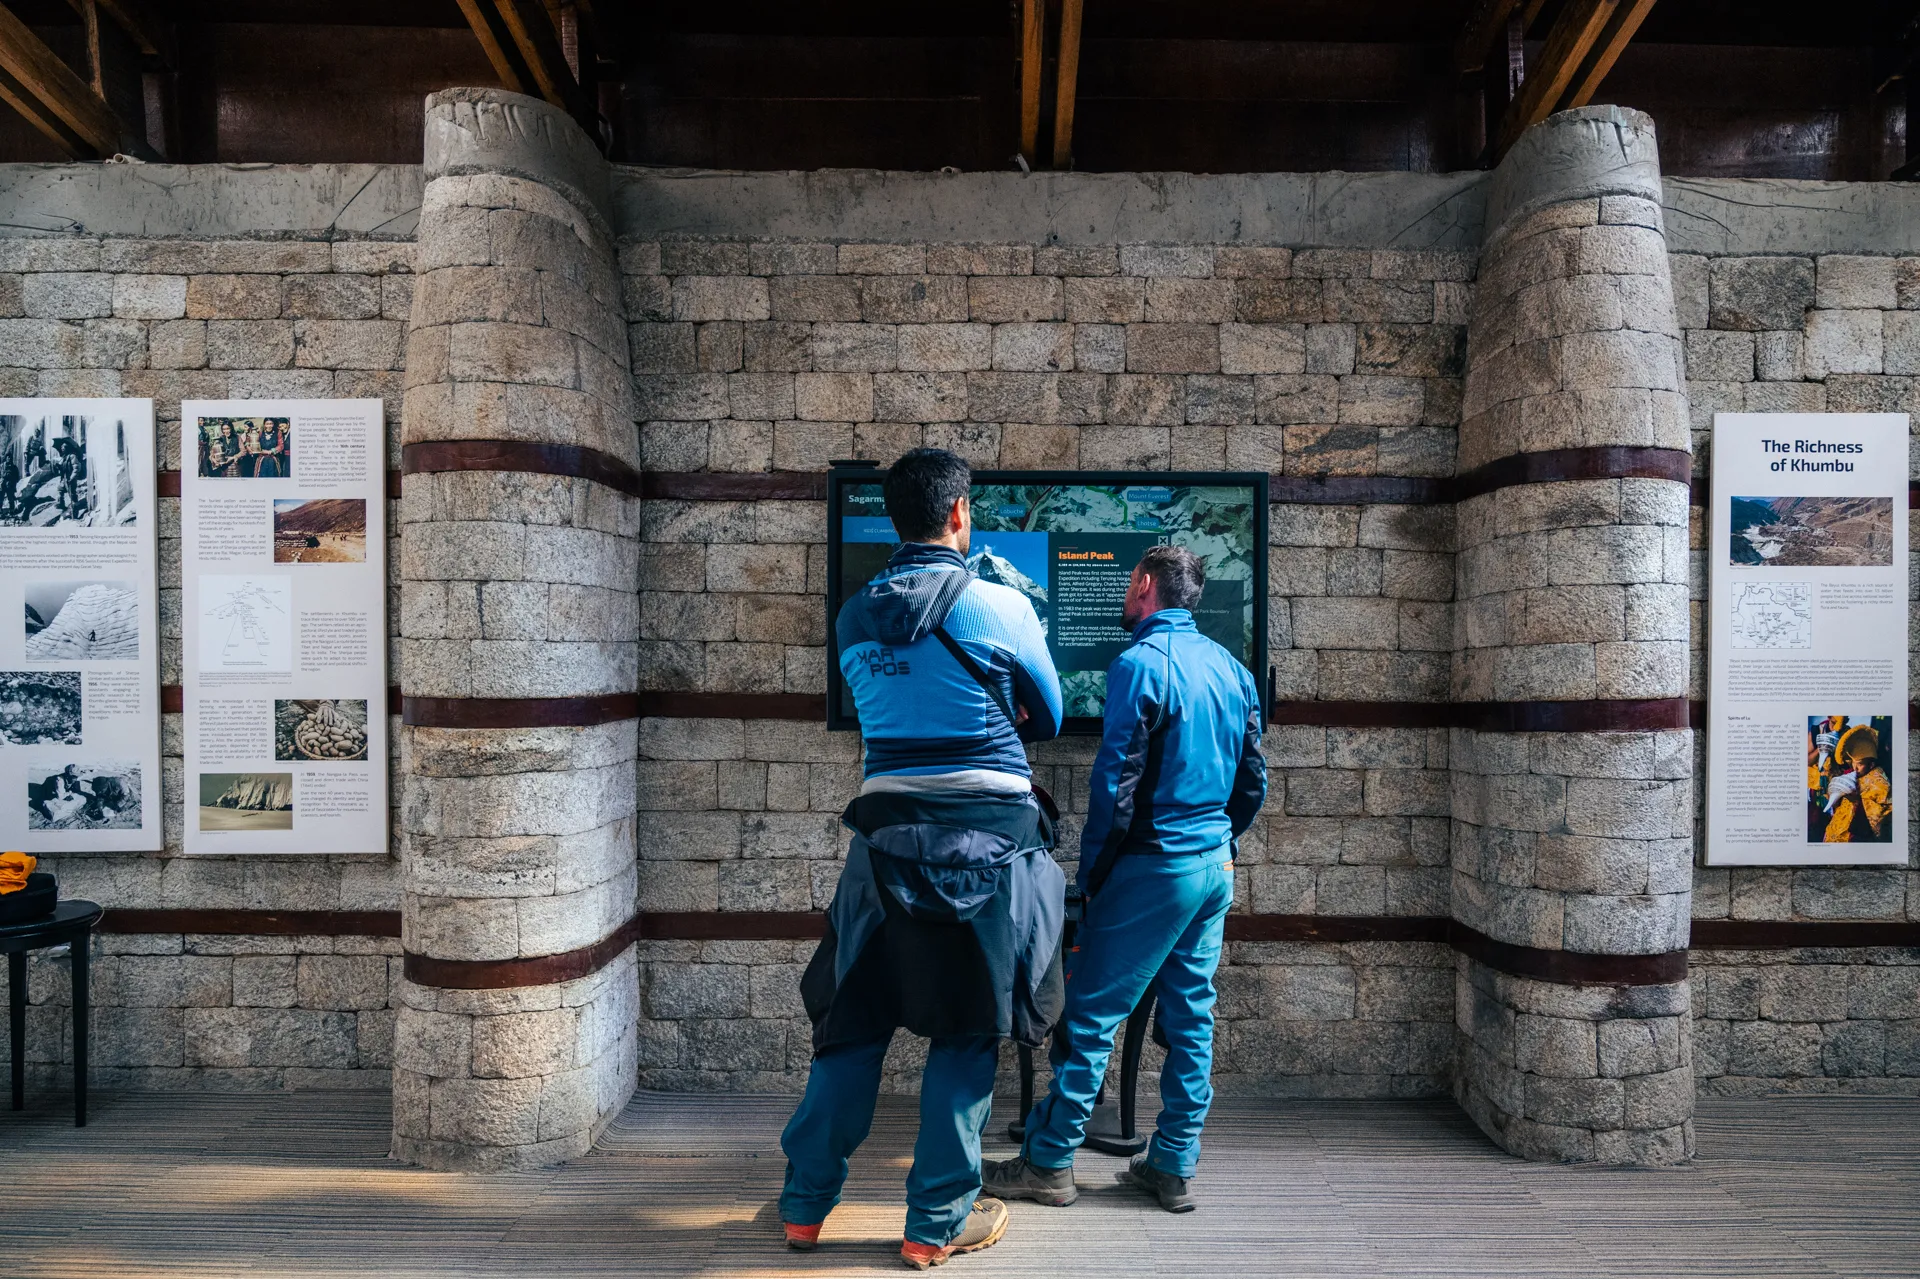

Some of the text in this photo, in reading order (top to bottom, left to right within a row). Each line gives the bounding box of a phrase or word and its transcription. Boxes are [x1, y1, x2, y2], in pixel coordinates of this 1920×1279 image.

[1762, 440, 1863, 453] The Richness
[1771, 459, 1854, 472] of Khumbu
